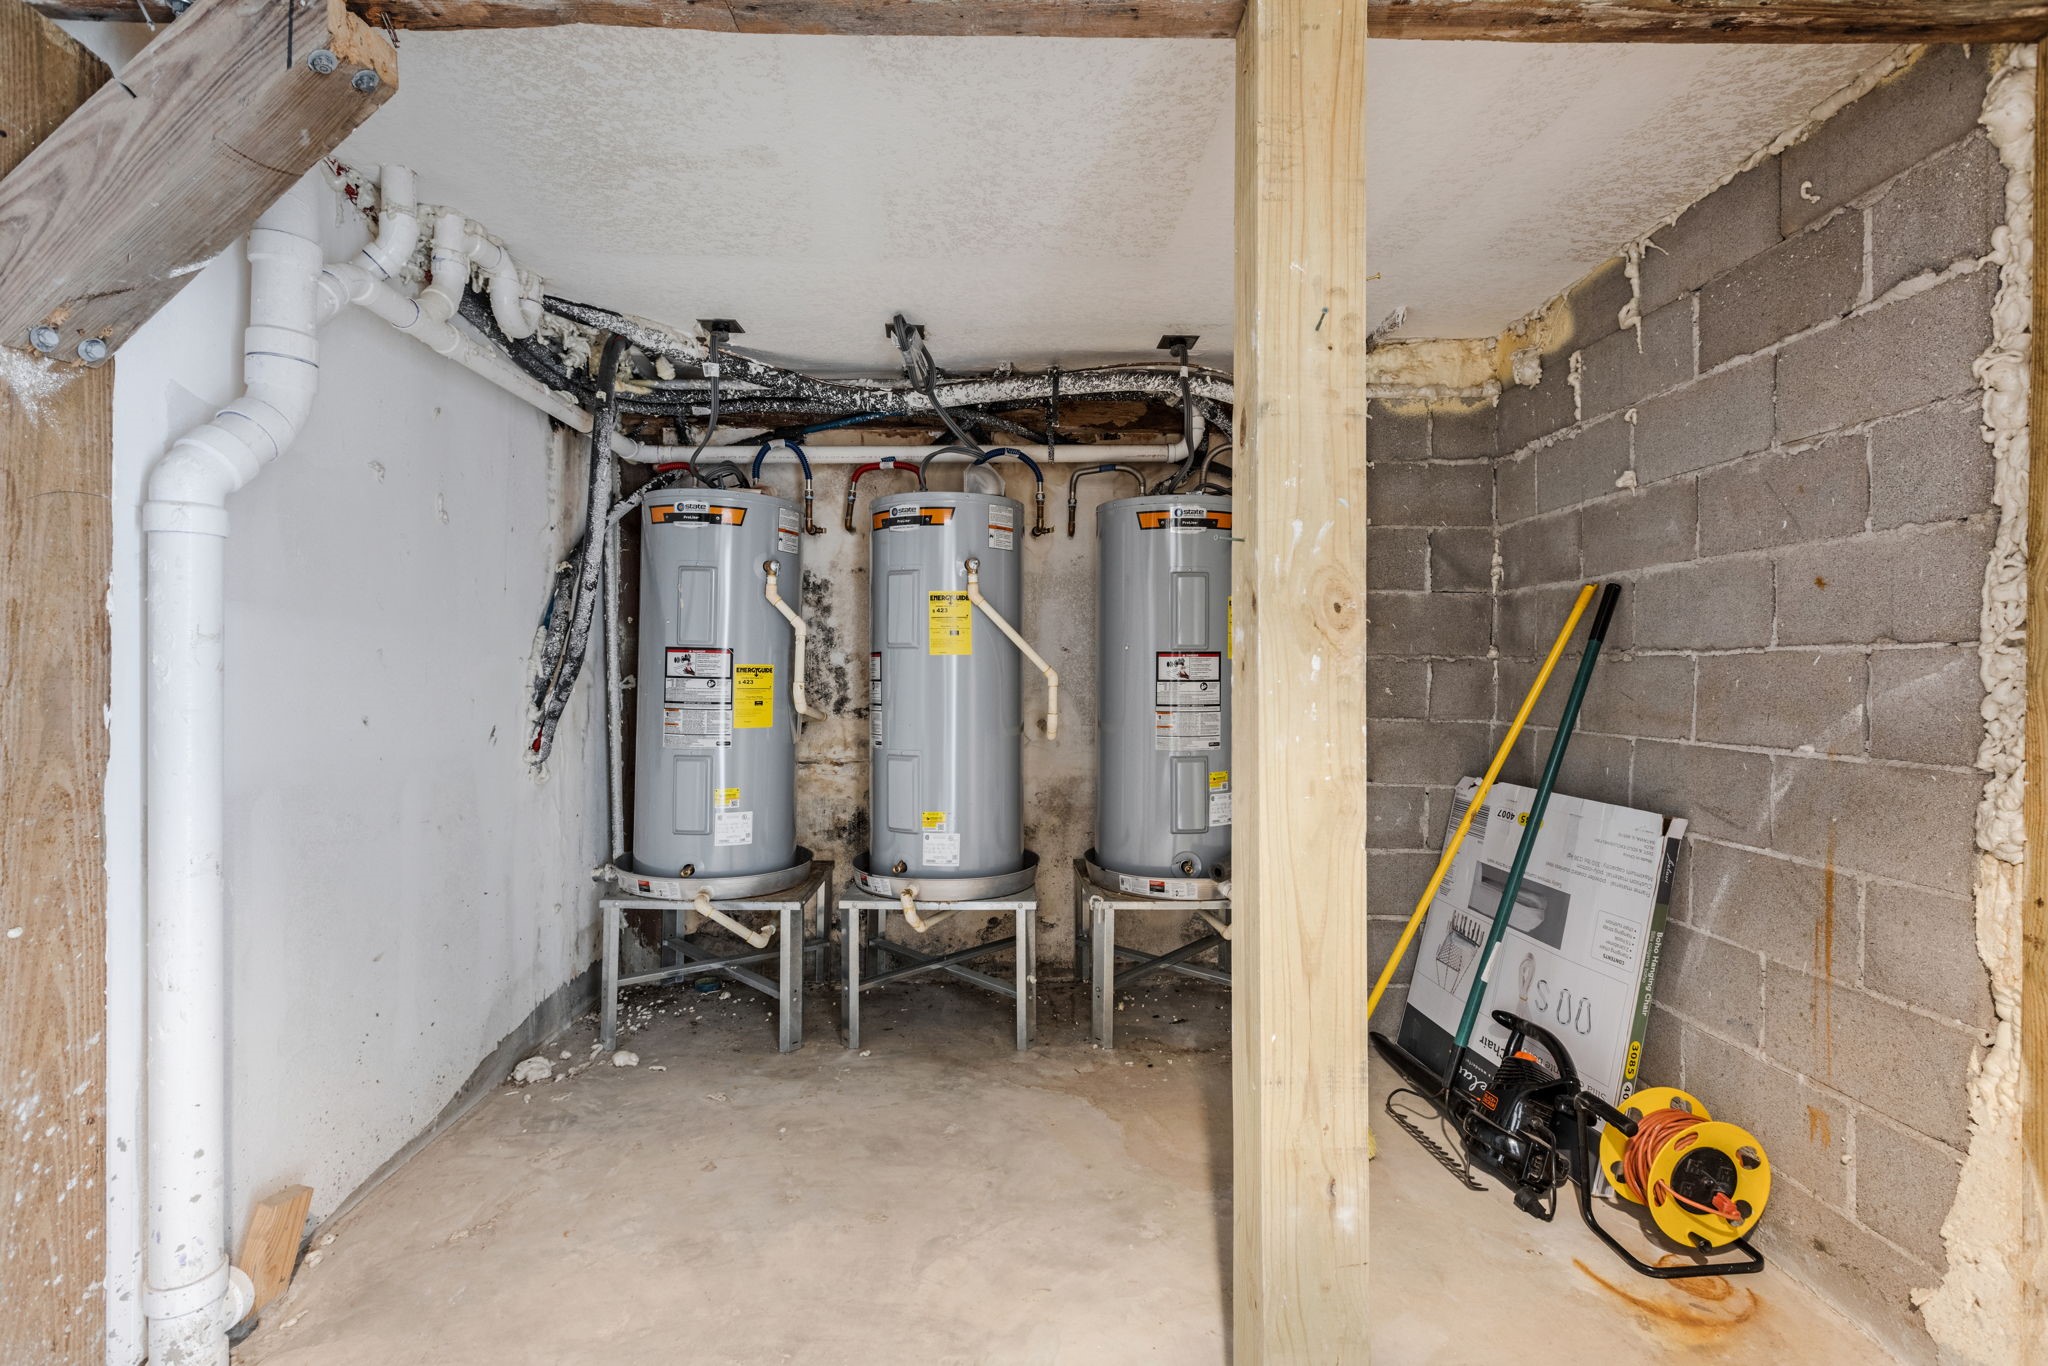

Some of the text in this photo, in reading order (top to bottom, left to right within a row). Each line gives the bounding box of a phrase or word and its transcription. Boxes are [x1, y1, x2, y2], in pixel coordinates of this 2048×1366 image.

[1497, 808, 1517, 820] 4007
[1602, 953, 1625, 966] CONTENTS
[1641, 931, 1664, 1017] Boho Hanging Chair
[1628, 1044, 1639, 1075] 3085
[1622, 1085, 1631, 1100] 40
